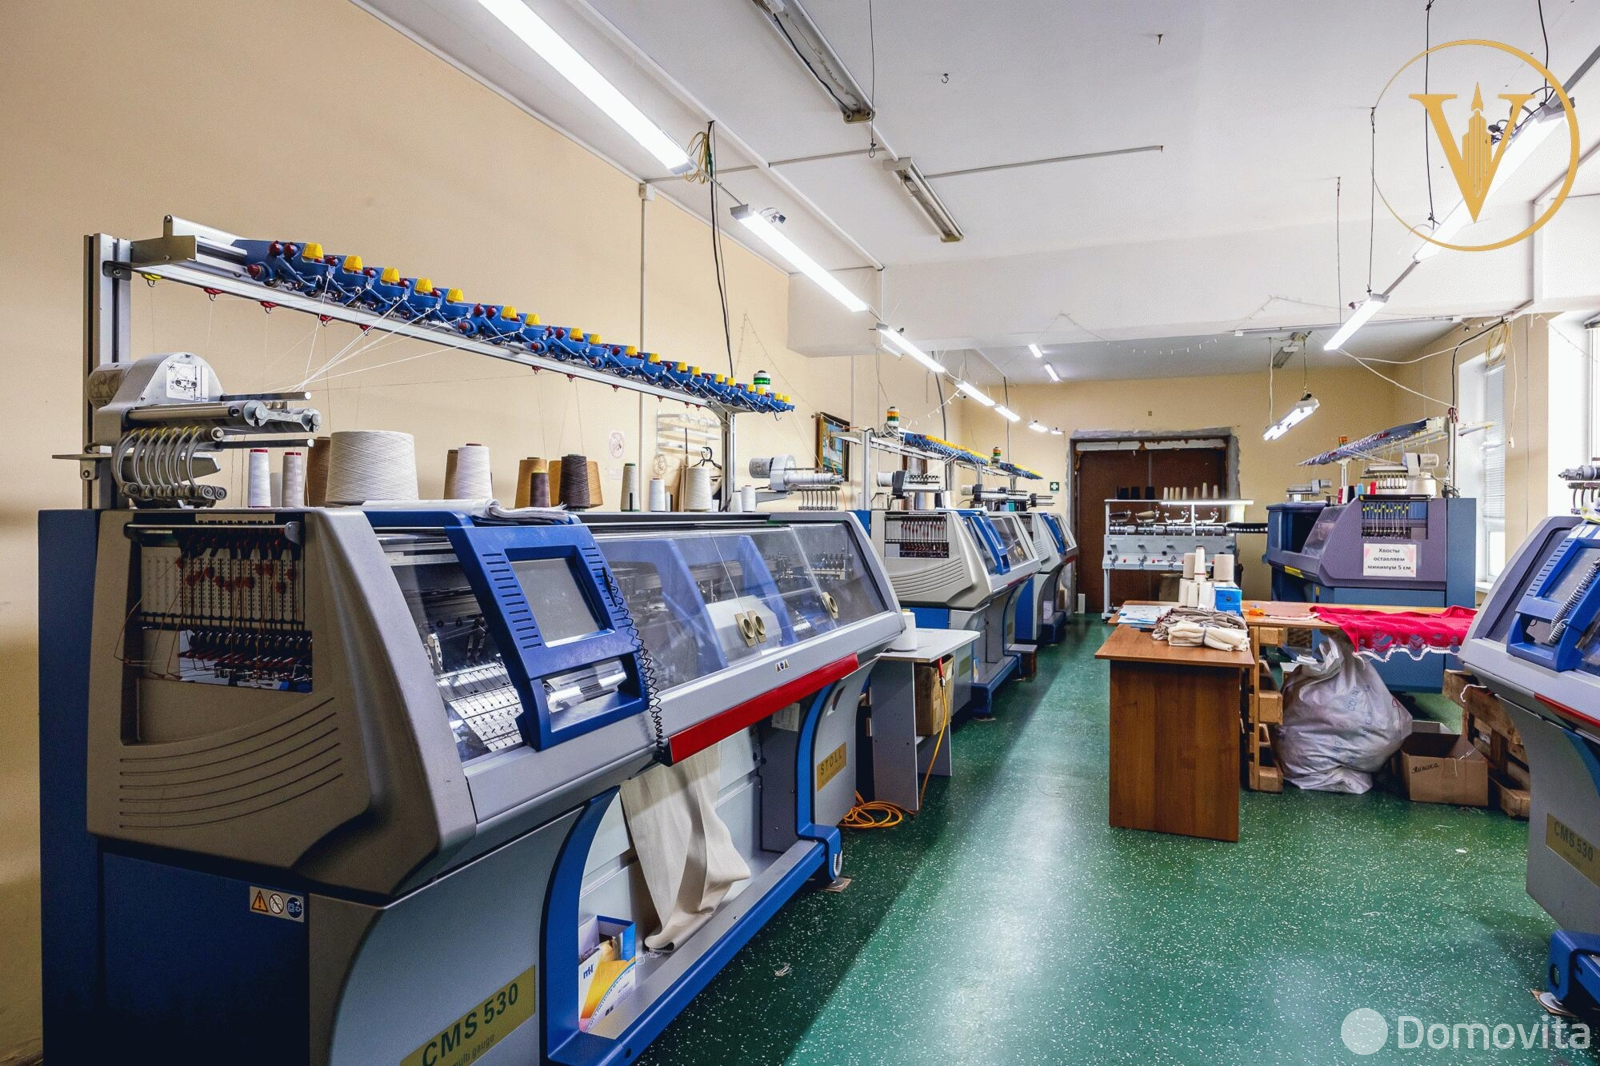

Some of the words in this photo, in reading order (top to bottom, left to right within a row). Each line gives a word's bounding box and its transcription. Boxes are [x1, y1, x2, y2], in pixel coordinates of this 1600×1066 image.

[820, 749, 843, 776] STOLL
[1554, 821, 1576, 848] CMS
[1576, 838, 1594, 862] 530
[422, 1011, 478, 1066] CMS
[483, 982, 519, 1025] 530
[471, 1033, 496, 1061] gauge
